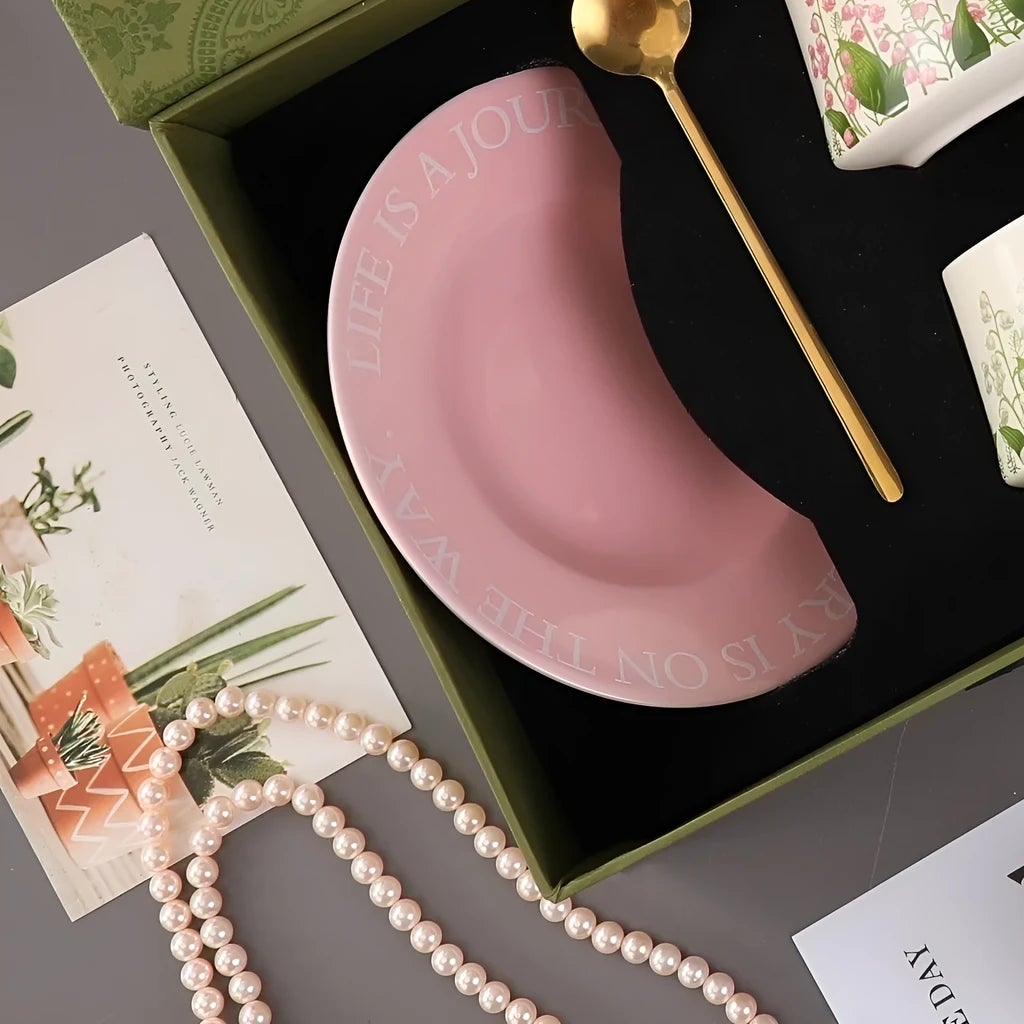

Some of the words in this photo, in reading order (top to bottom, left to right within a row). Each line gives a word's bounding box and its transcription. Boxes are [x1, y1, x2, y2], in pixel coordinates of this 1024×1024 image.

[346, 247, 394, 378] LIFE
[373, 187, 419, 247] IS
[418, 151, 457, 199] A
[117, 356, 172, 452] PHOTOGRAPHY
[171, 457, 190, 484] JACK
[143, 361, 177, 419] STYLING
[175, 423, 196, 456] LUCIE
[194, 460, 223, 506] LAWMAN
[476, 586, 597, 675] THE
[615, 647, 709, 690] ON
[721, 635, 777, 682] IS
[903, 944, 956, 1011] DAY
